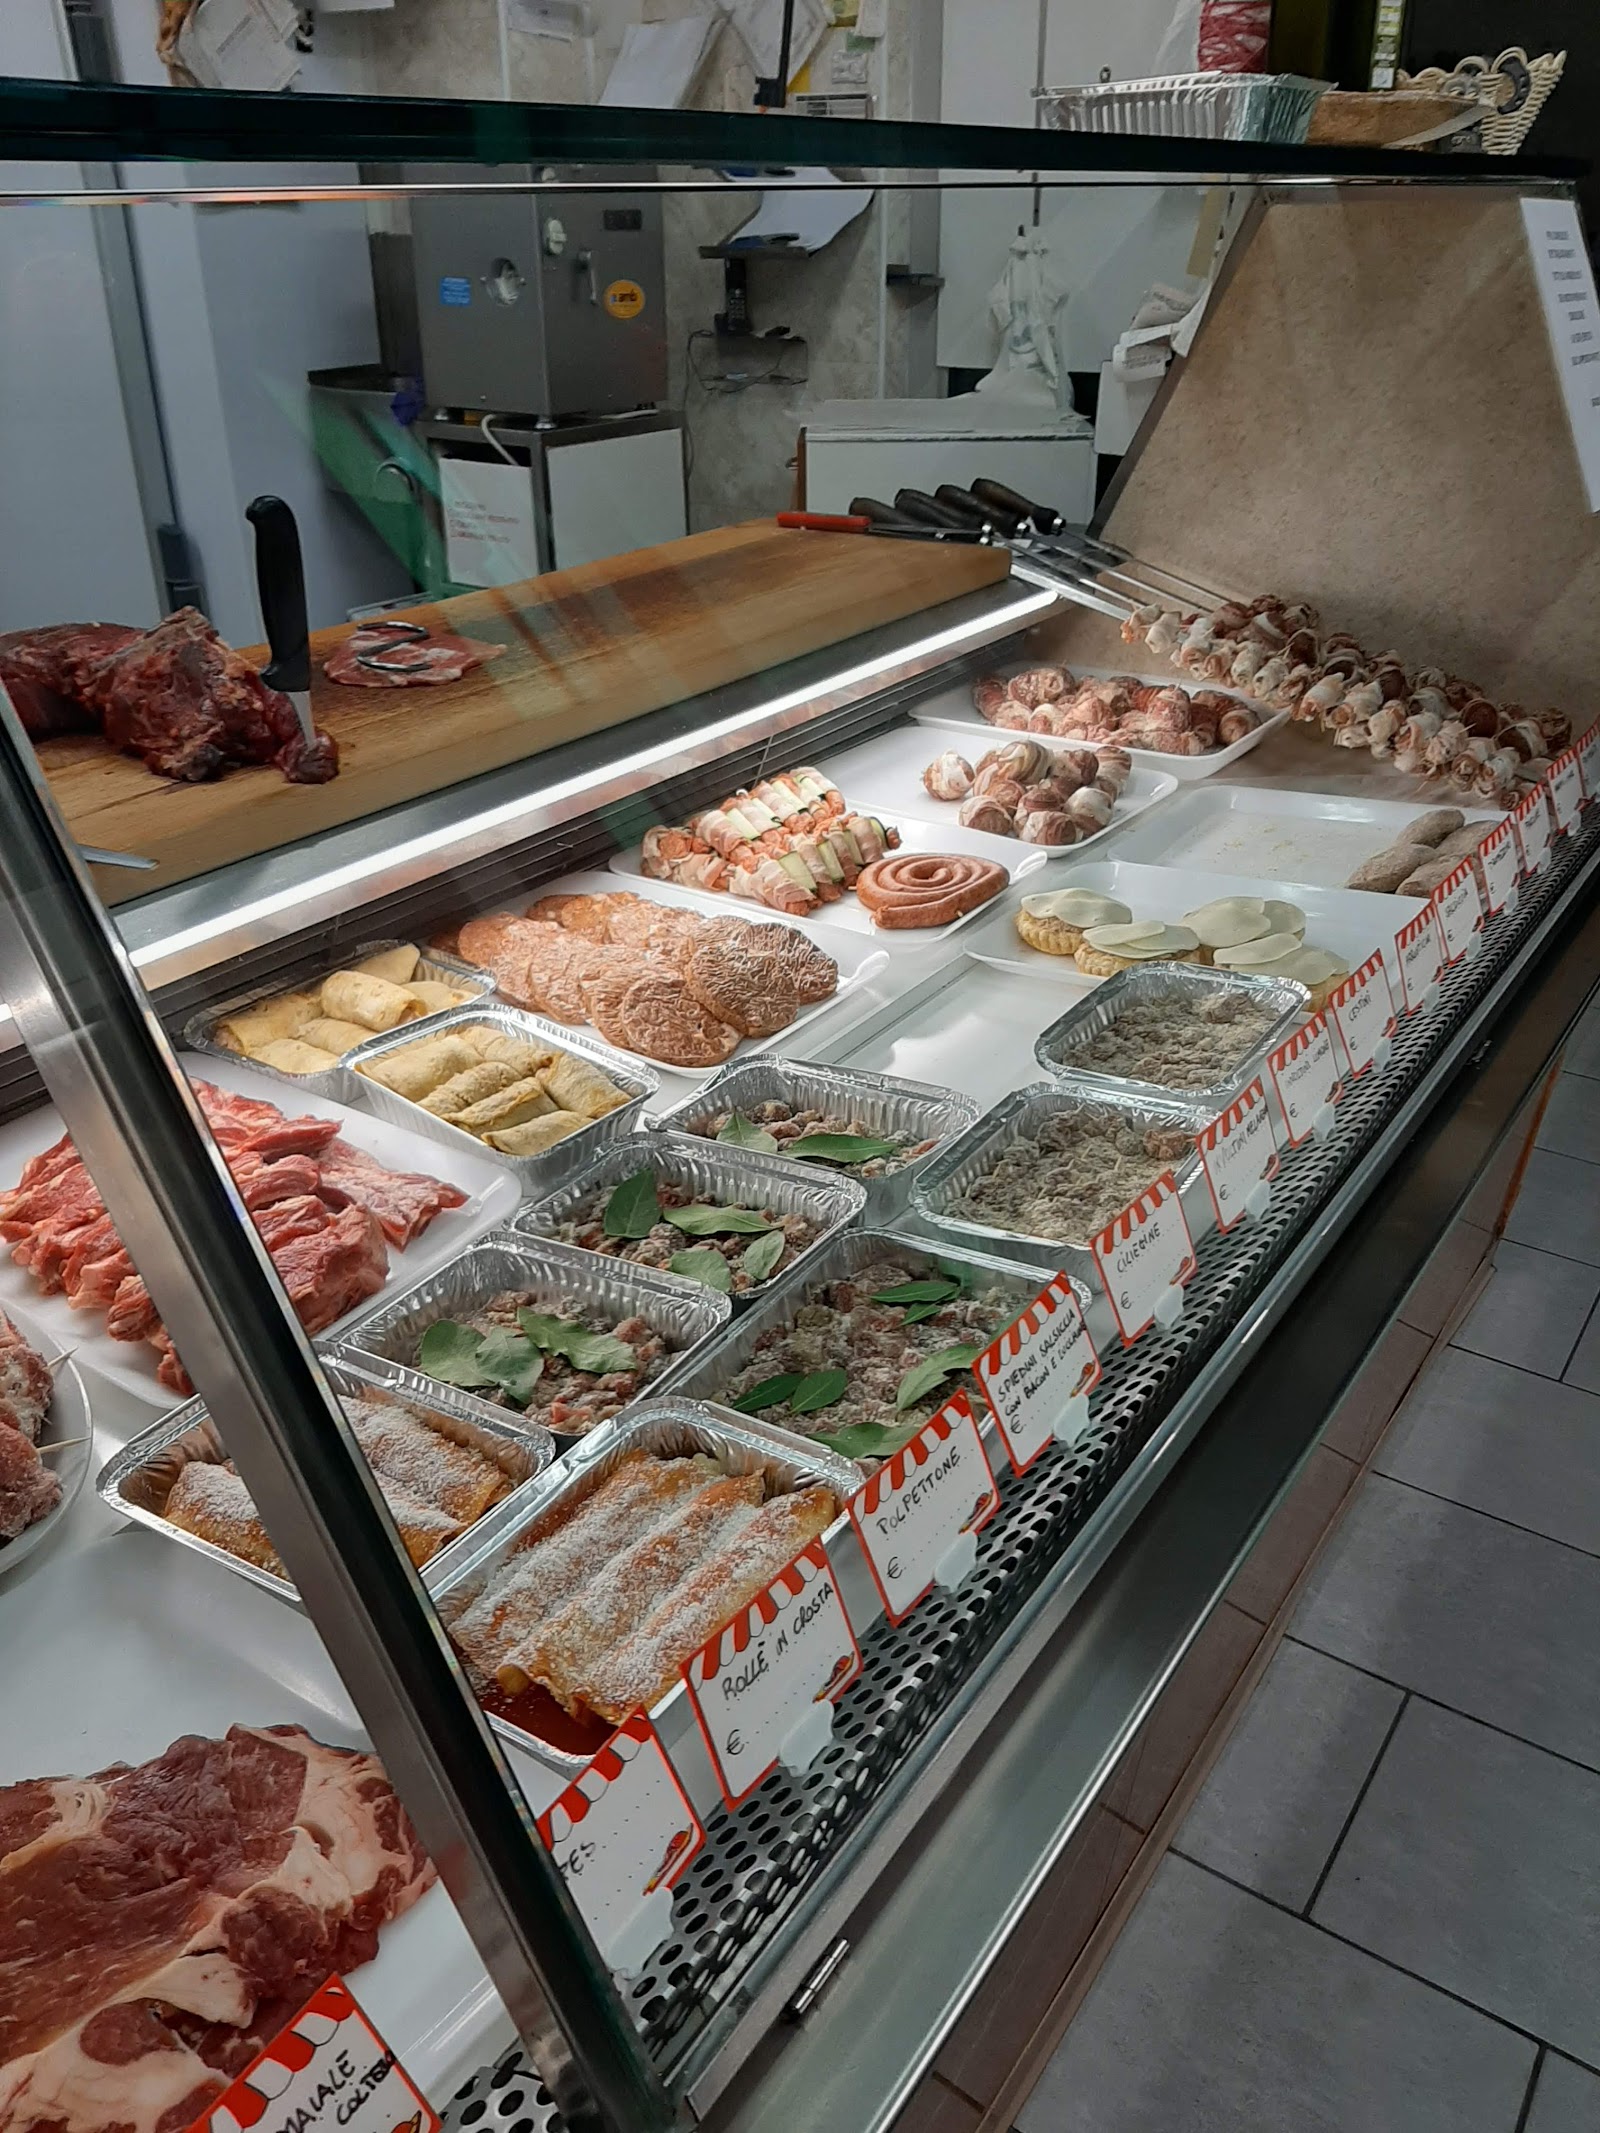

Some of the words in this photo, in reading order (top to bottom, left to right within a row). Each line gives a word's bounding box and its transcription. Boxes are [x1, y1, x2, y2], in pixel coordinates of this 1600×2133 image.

[1348, 990, 1371, 1021] CESTINI
[1289, 1103, 1299, 1117] €
[1219, 1183, 1231, 1200] €
[1116, 1221, 1161, 1273] CILIEGINE
[1120, 1291, 1132, 1309] €
[998, 1354, 1038, 1403] SPIEDINI
[1039, 1308, 1076, 1358] SALSICCIA
[1004, 1395, 1021, 1416] CON
[1023, 1365, 1051, 1400] BACON
[1050, 1356, 1058, 1370] E
[1010, 1413, 1024, 1434] €
[876, 1446, 961, 1534] POLPETTONE
[886, 1556, 903, 1579] €
[776, 1629, 789, 1656] IN
[793, 1582, 834, 1635] CROSTA
[726, 1729, 745, 1755] €
